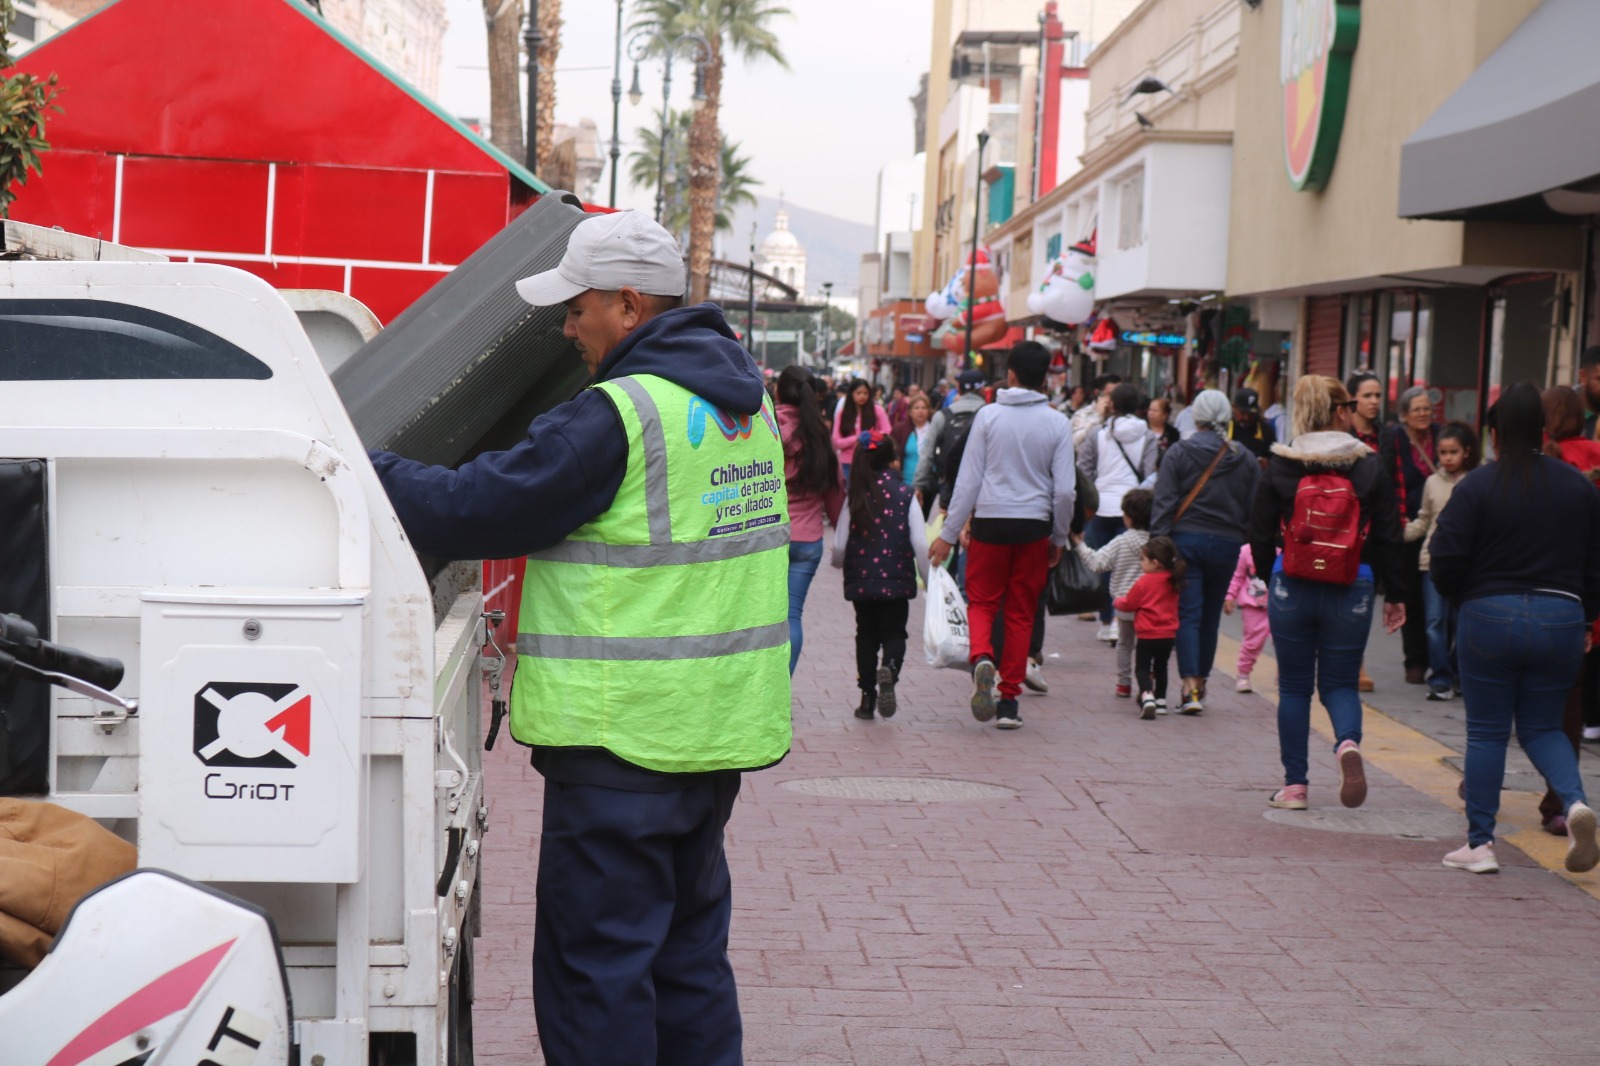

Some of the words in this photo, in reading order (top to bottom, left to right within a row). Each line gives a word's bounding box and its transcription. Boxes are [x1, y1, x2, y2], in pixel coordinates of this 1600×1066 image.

[711, 459, 773, 486] Chihuahua
[702, 484, 739, 506] capital
[741, 483, 751, 497] de
[753, 476, 781, 493] trabajo
[716, 507, 723, 523] y
